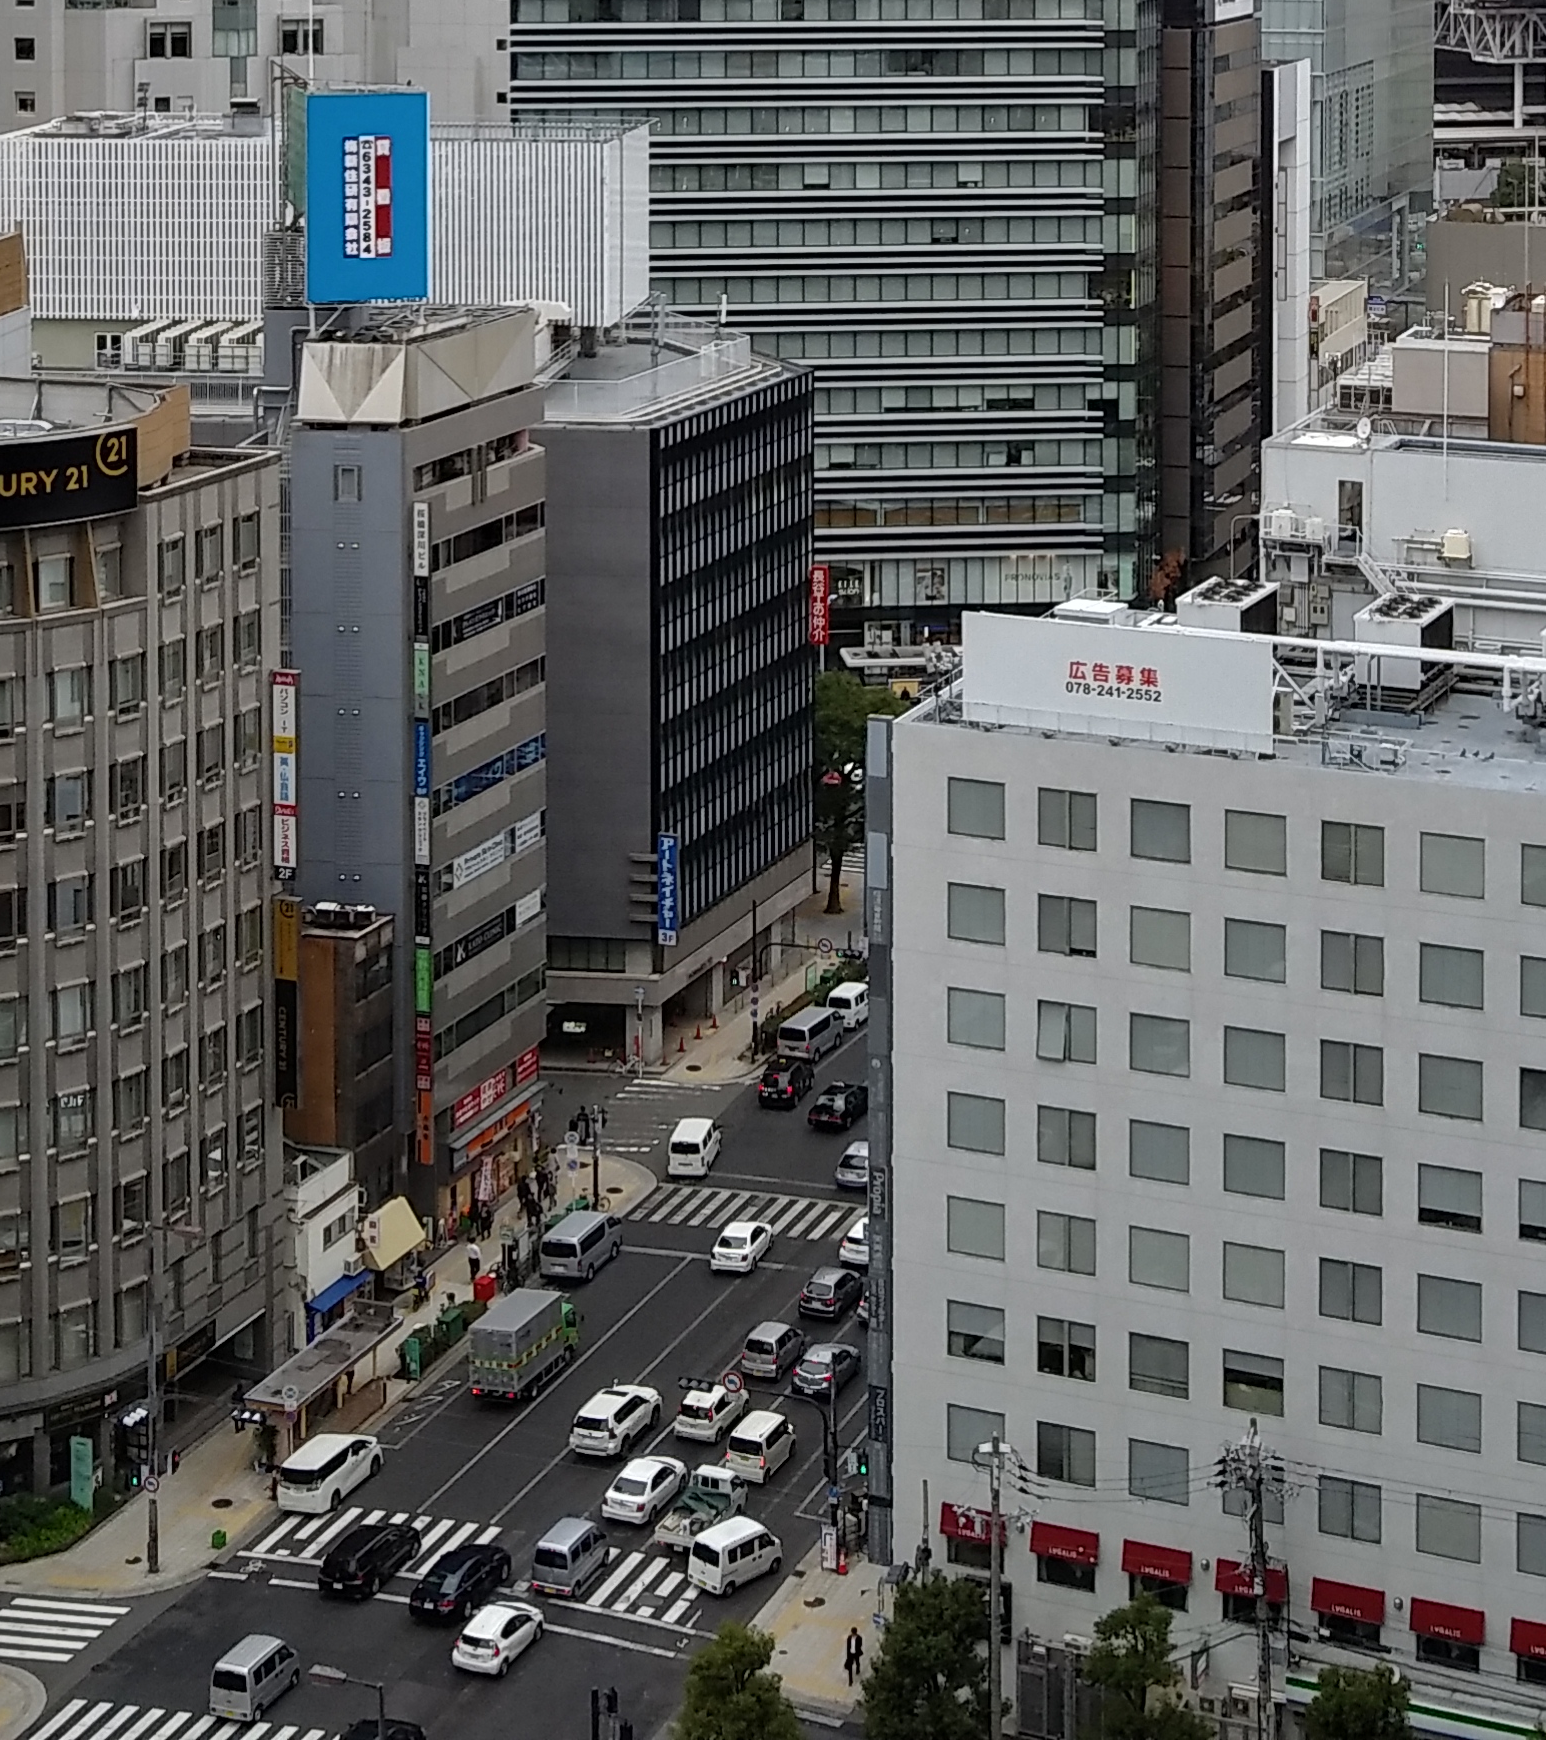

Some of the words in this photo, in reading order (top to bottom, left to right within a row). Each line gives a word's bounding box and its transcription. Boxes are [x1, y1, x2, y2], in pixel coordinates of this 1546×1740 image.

[362, 151, 373, 255] 6343-2584
[65, 465, 89, 491] 21
[1068, 660, 1159, 688] 広告募集
[1064, 681, 1163, 703] 078-241-2552
[277, 867, 293, 879] 2F
[660, 836, 675, 929] アートネイチャー
[660, 932, 674, 943] 3F
[278, 1006, 287, 1059] CENTURY
